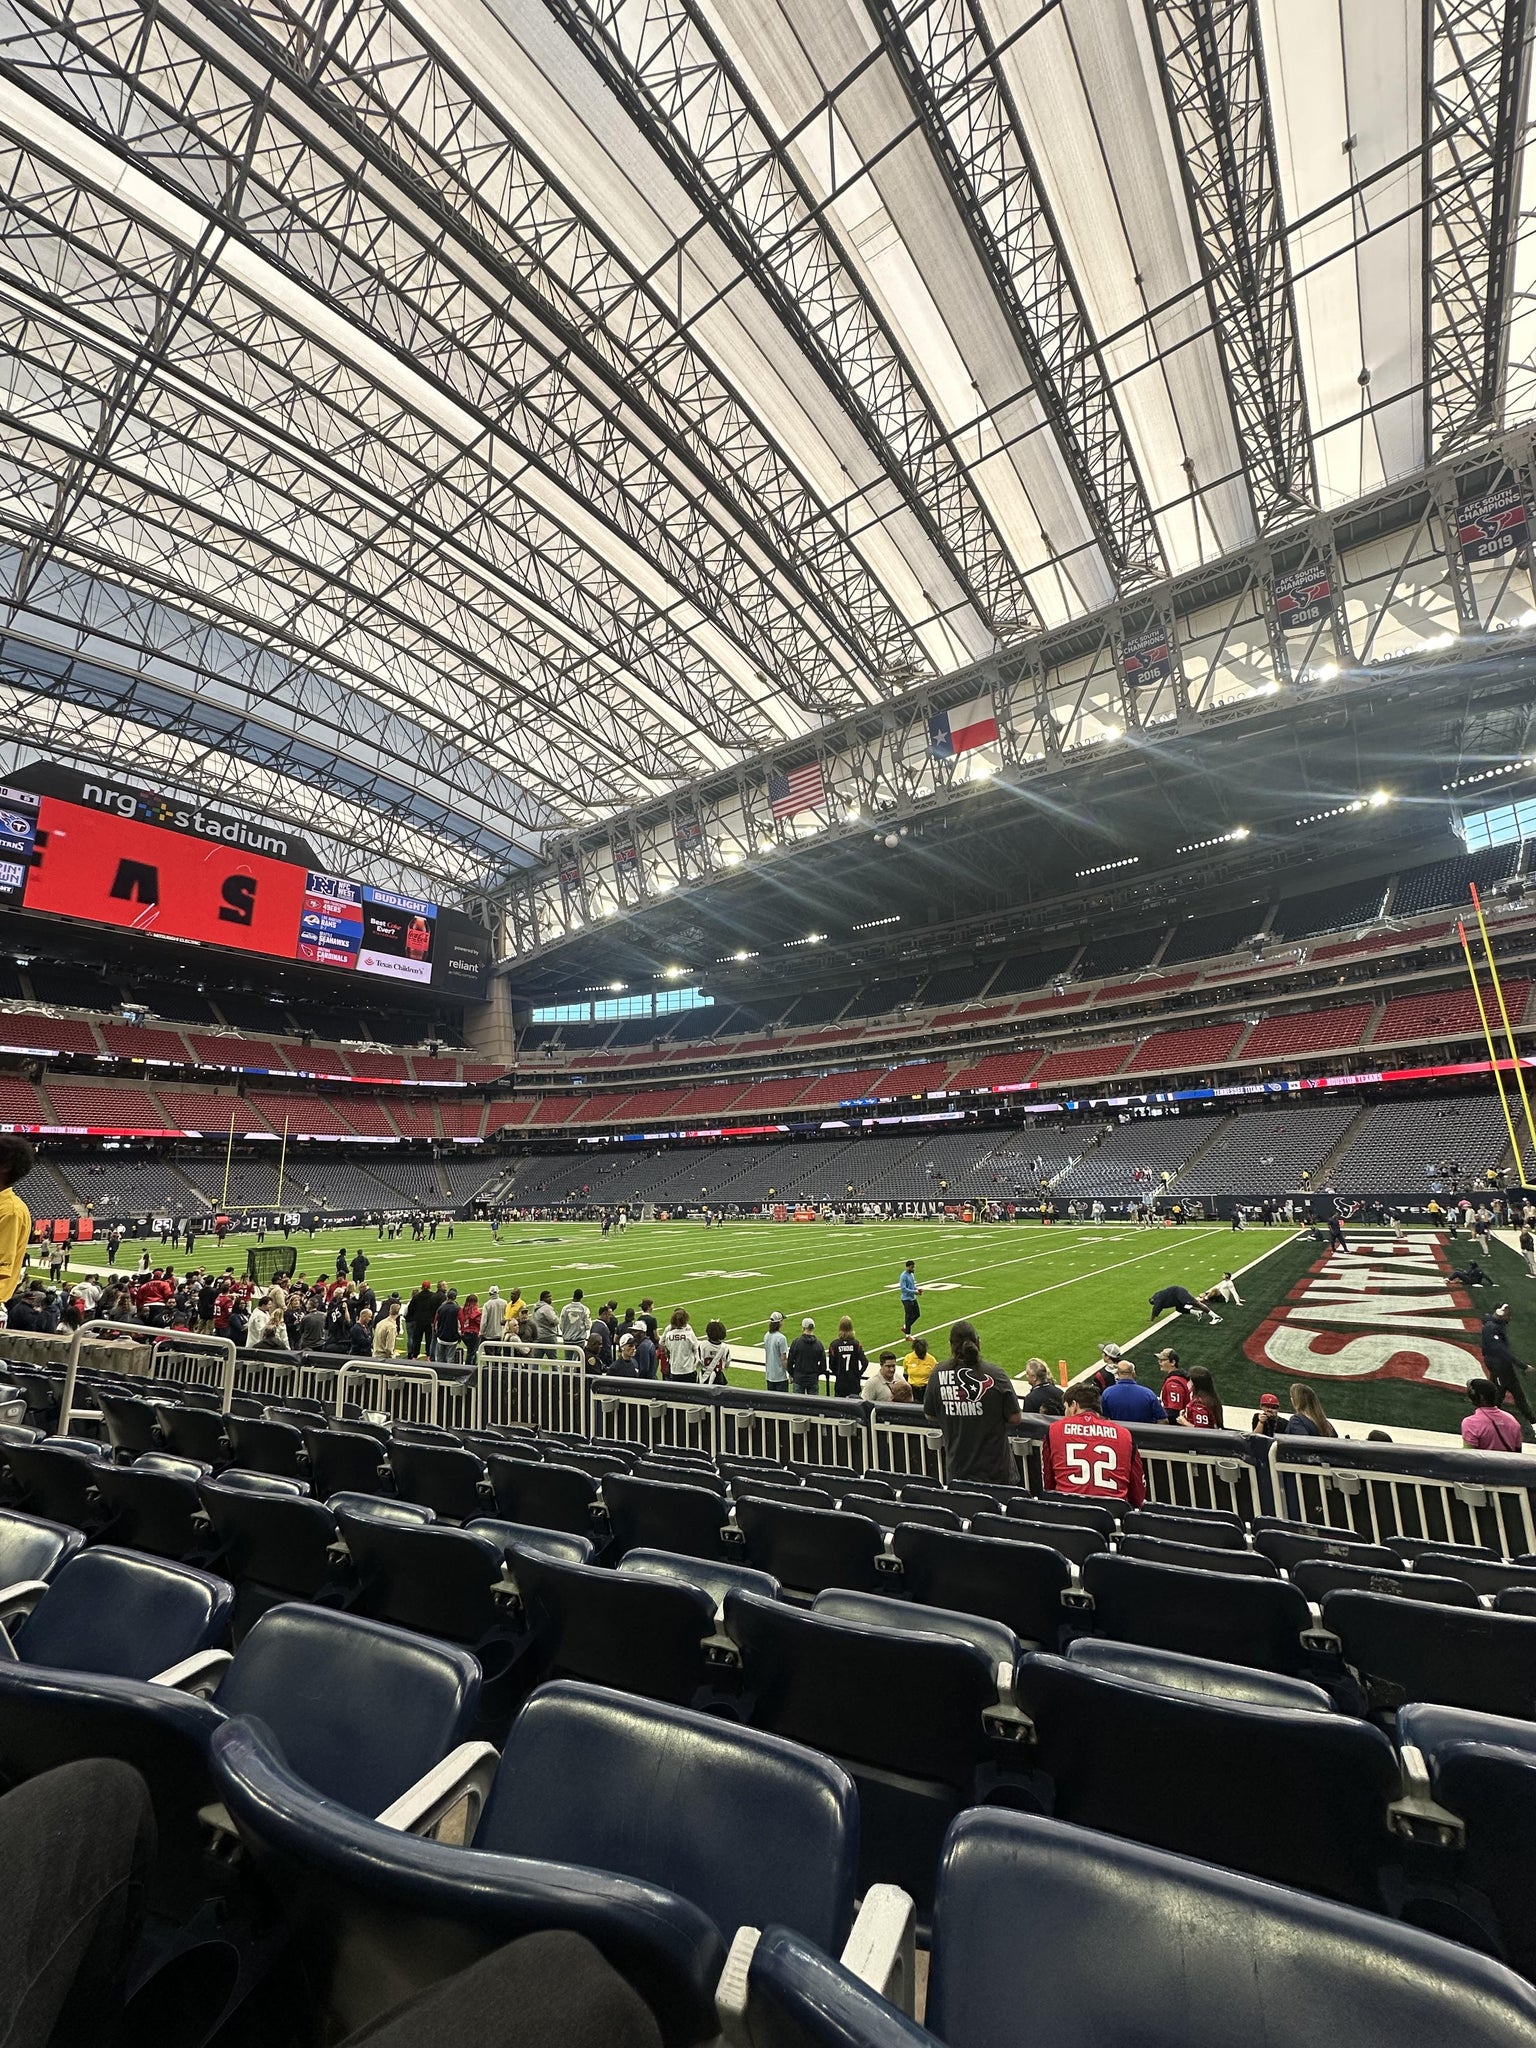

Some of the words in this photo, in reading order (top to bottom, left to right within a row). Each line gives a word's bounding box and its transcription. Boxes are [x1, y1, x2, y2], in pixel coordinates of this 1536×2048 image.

[1459, 493, 1520, 523] CHAMPIONS
[1464, 503, 1480, 513] AFC
[1482, 489, 1512, 506] SOUTH
[1479, 535, 1513, 556] 2019
[1276, 570, 1325, 593] CHAMPIONS
[1280, 576, 1293, 585] AFC
[1295, 566, 1318, 578] SOUTH
[1292, 607, 1319, 625] 2018
[1140, 631, 1159, 641] SOUTH
[1124, 634, 1164, 654] CHAMPIONS
[1138, 668, 1160, 683] 2016
[83, 784, 137, 818] nrg
[174, 810, 288, 855] stadium
[338, 881, 350, 890] NFC
[338, 888, 355, 898] WEST
[323, 904, 341, 913] 49ERS
[374, 892, 396, 906] BUD
[397, 897, 426, 912] LIGHT
[321, 920, 336, 929] RAMS
[370, 918, 386, 926] Best
[376, 926, 395, 935] Ever?
[319, 936, 349, 948] SEAHAWKS
[317, 951, 347, 962] CARDINALS
[376, 960, 392, 969] Texas
[394, 964, 423, 975] Children's
[449, 960, 479, 972] reliant
[1214, 1086, 1244, 1096] TENNESSEE
[1245, 1085, 1265, 1094] TITANS
[1326, 1075, 1356, 1086] HOUSTON
[1356, 1073, 1383, 1083] TEXANS
[842, 1354, 851, 1371] 7
[938, 1370, 955, 1385] WE
[940, 1386, 960, 1400] ARE
[1170, 1392, 1180, 1402] 51
[943, 1401, 983, 1416] TEXANS
[1196, 1414, 1209, 1424] 99
[1064, 1424, 1117, 1439] GREENARD
[1066, 1443, 1117, 1490] 52
